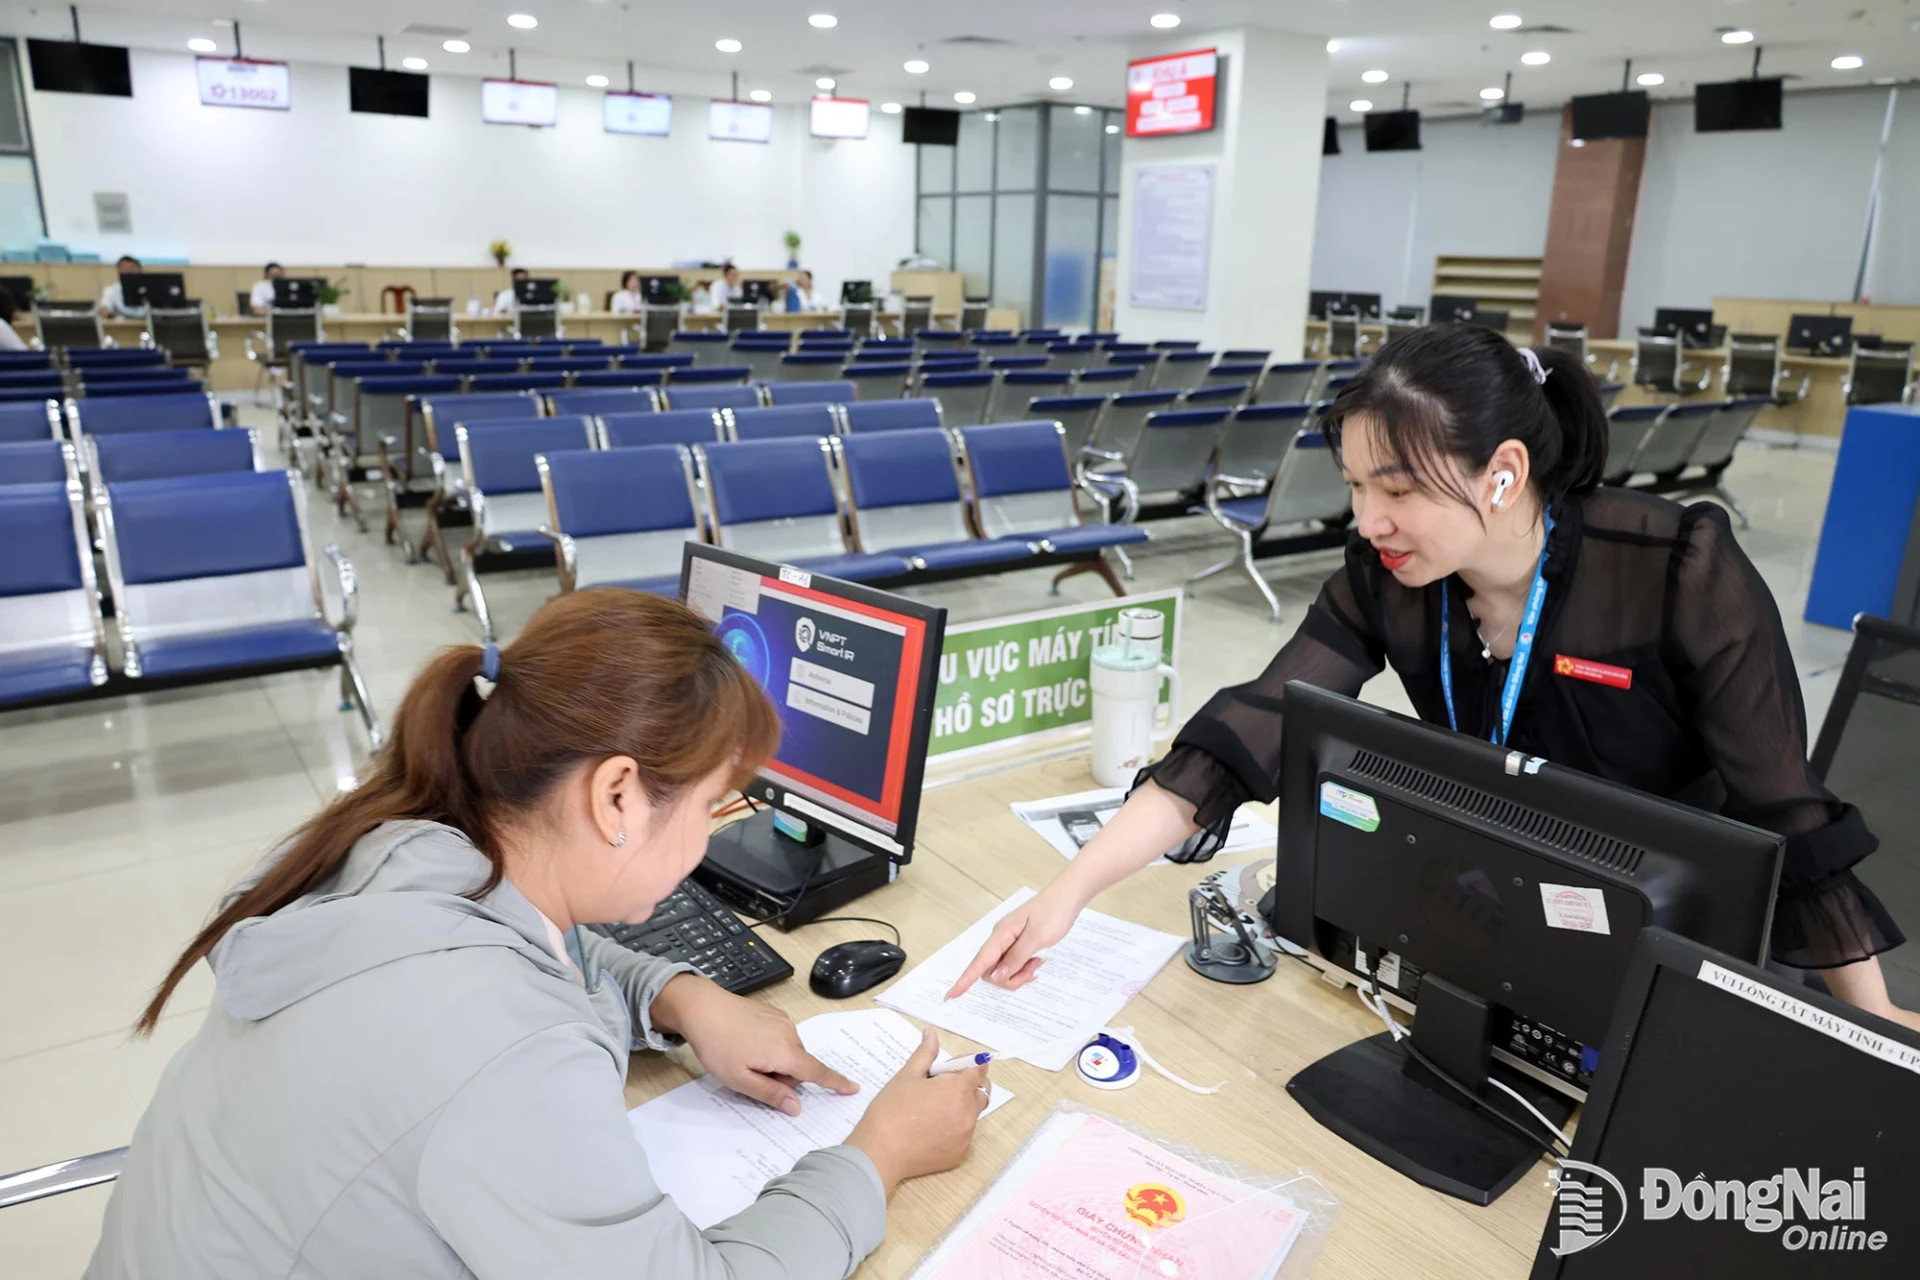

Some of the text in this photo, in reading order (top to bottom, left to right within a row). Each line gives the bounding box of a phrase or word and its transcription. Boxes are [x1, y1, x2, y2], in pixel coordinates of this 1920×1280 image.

[818, 629, 847, 646] VNPT
[966, 640, 1020, 682] VỰC
[1028, 626, 1083, 668] MÁY
[935, 678, 1086, 737] HỒ SƠ TRỰC
[1713, 970, 1735, 988] VUI
[1738, 982, 1776, 1006] LÒNG
[1811, 1012, 1846, 1034] MÁY
[1848, 1027, 1885, 1052] TÍNH
[1899, 1050, 1920, 1068] UP
